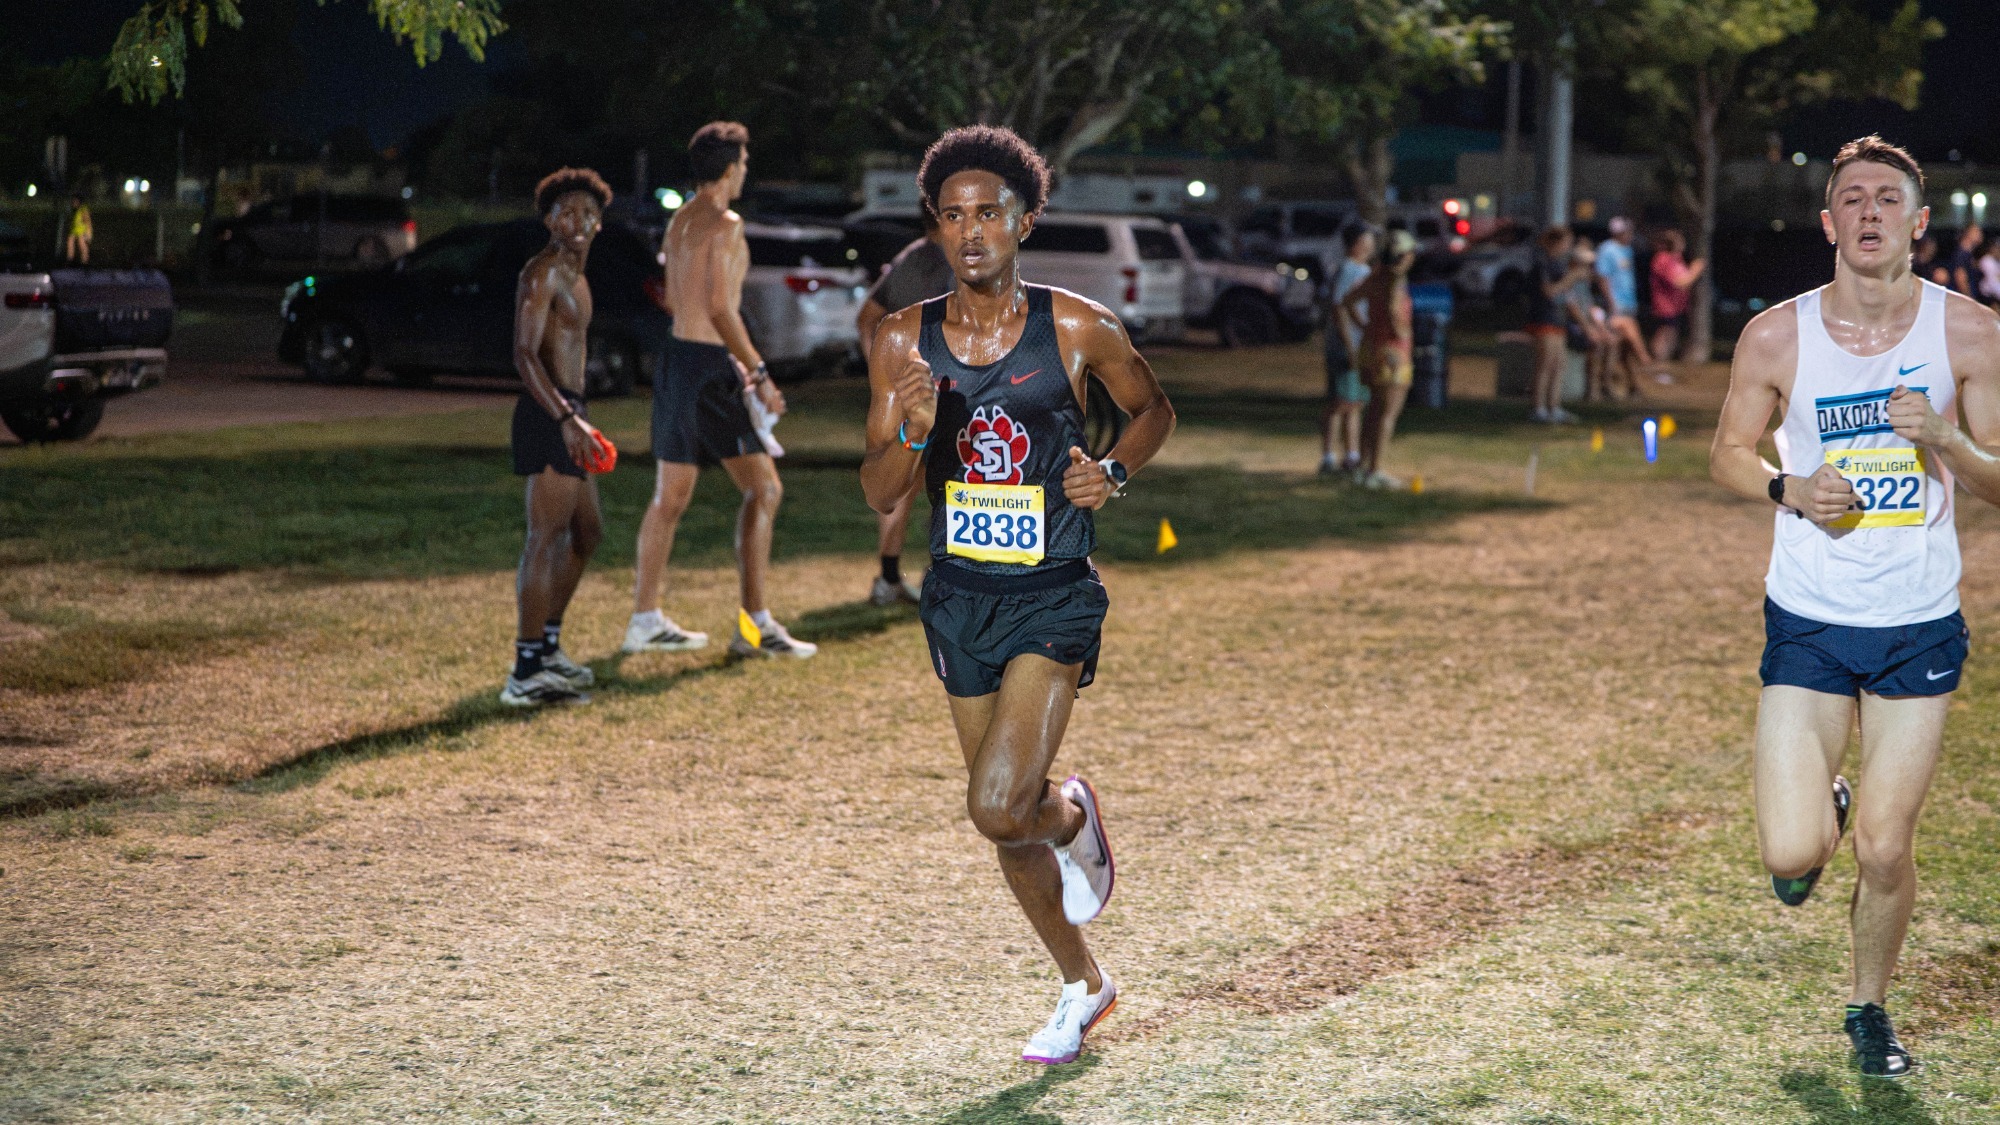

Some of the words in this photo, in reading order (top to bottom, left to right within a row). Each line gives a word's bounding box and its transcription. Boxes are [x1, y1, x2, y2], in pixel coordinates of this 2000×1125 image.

[1817, 401, 1880, 434] DAKOTA
[1854, 461, 1916, 473] TWILIGHT
[969, 496, 1032, 510] TWILIGHT
[1843, 477, 1919, 511] 322
[953, 510, 1038, 550] 2838
